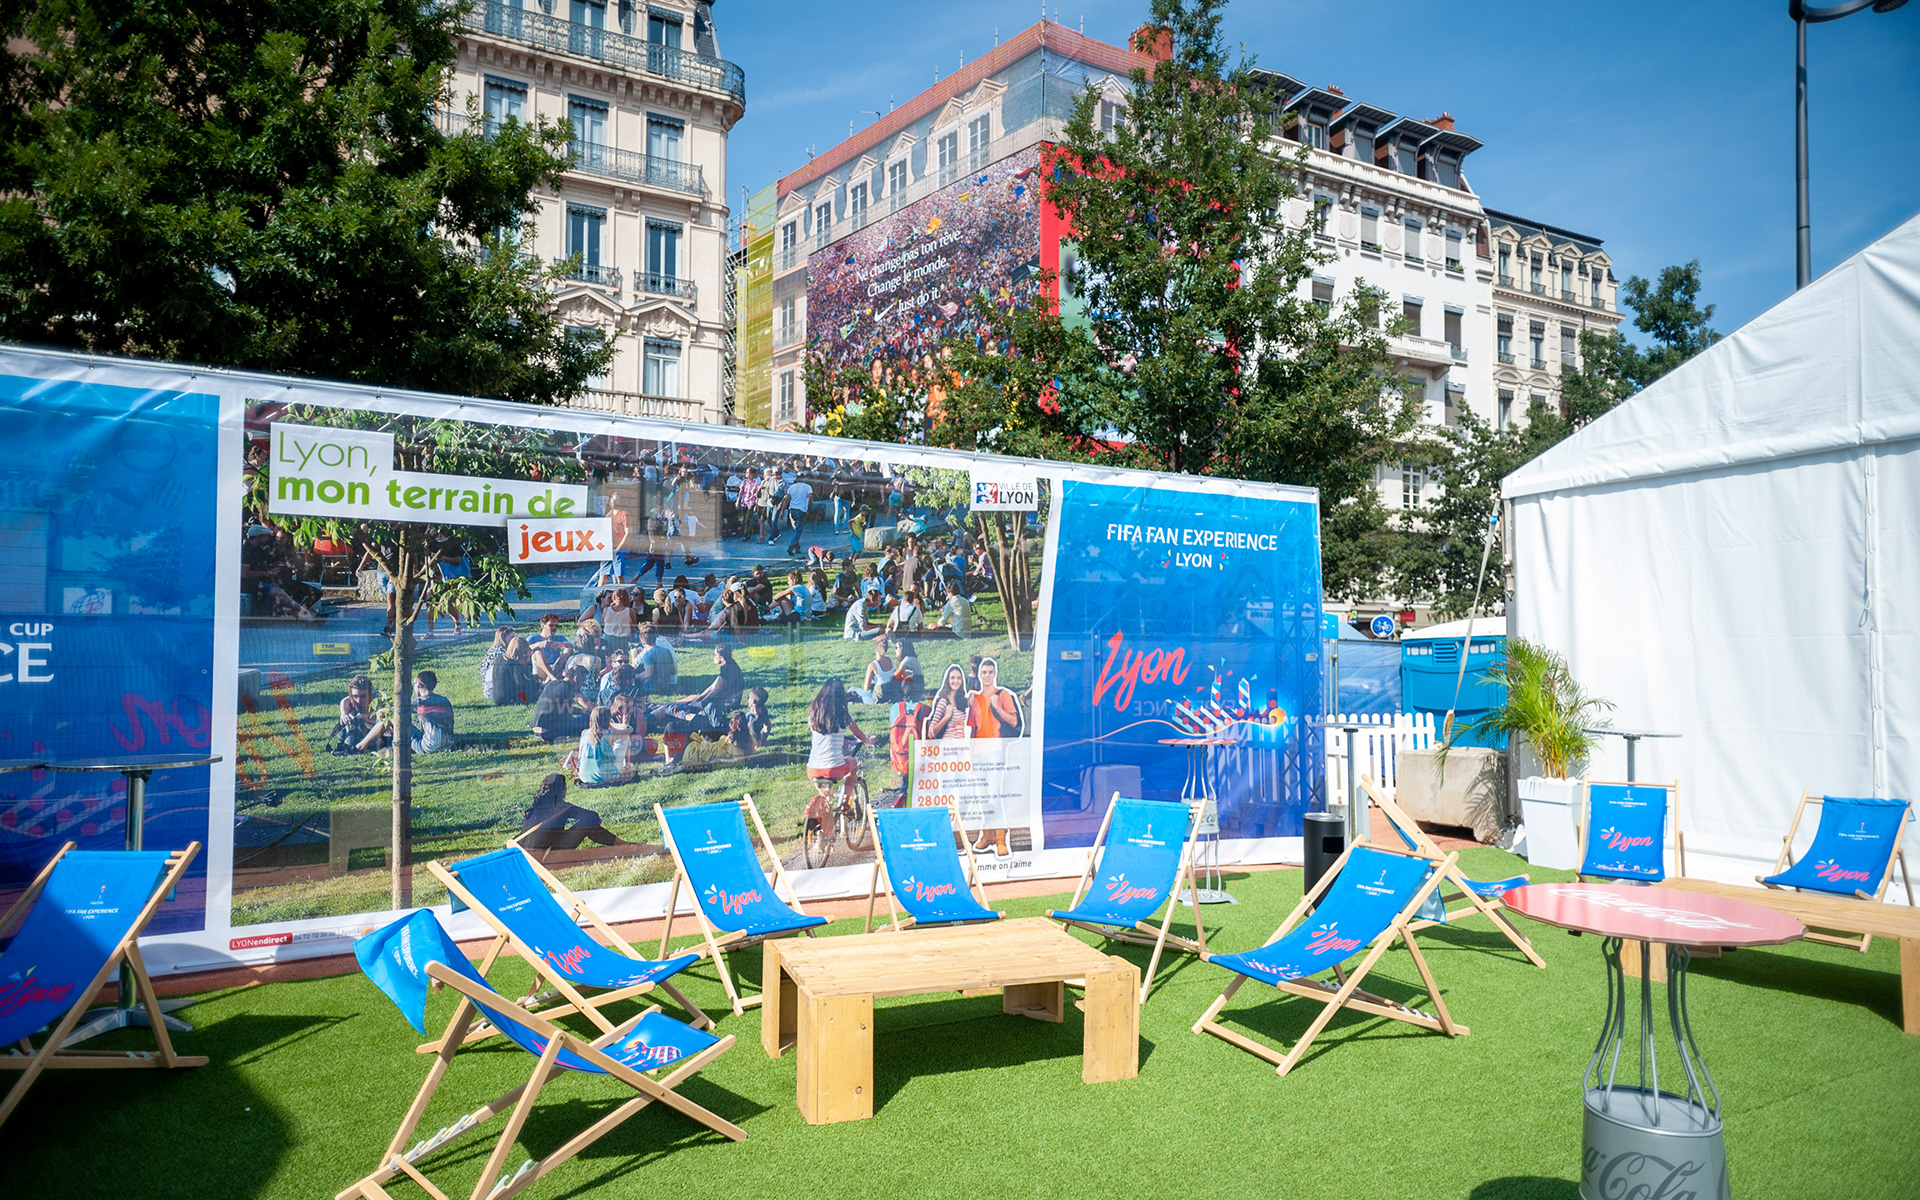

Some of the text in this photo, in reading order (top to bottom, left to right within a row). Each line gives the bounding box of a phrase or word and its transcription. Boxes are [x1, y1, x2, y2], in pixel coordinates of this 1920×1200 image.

[856, 230, 964, 284] Ne change pas ton rêve.
[868, 255, 948, 297] Change le monde.
[898, 296, 915, 316] Just
[917, 290, 930, 305] do
[279, 431, 377, 477] Lyon,
[278, 476, 576, 518] mon terrain de
[1000, 492, 1033, 504] LYON
[518, 524, 606, 560] jeux.
[1107, 524, 1278, 551] FIFA FAN EXPERIENCE
[1176, 552, 1212, 568] LYON
[9, 623, 54, 636] CUP
[1092, 630, 1192, 712] Lyon
[920, 746, 940, 757] 350
[918, 778, 938, 790] 200
[918, 796, 932, 807] 28
[1608, 832, 1654, 851] Lyon
[1817, 864, 1871, 882] Lyon
[719, 889, 762, 915] Lyon
[916, 881, 956, 902] Lyon
[1108, 880, 1158, 904] Lyon
[232, 936, 288, 948] LYONendirect
[1305, 929, 1362, 955] Lyon
[549, 945, 591, 974] Lyon
